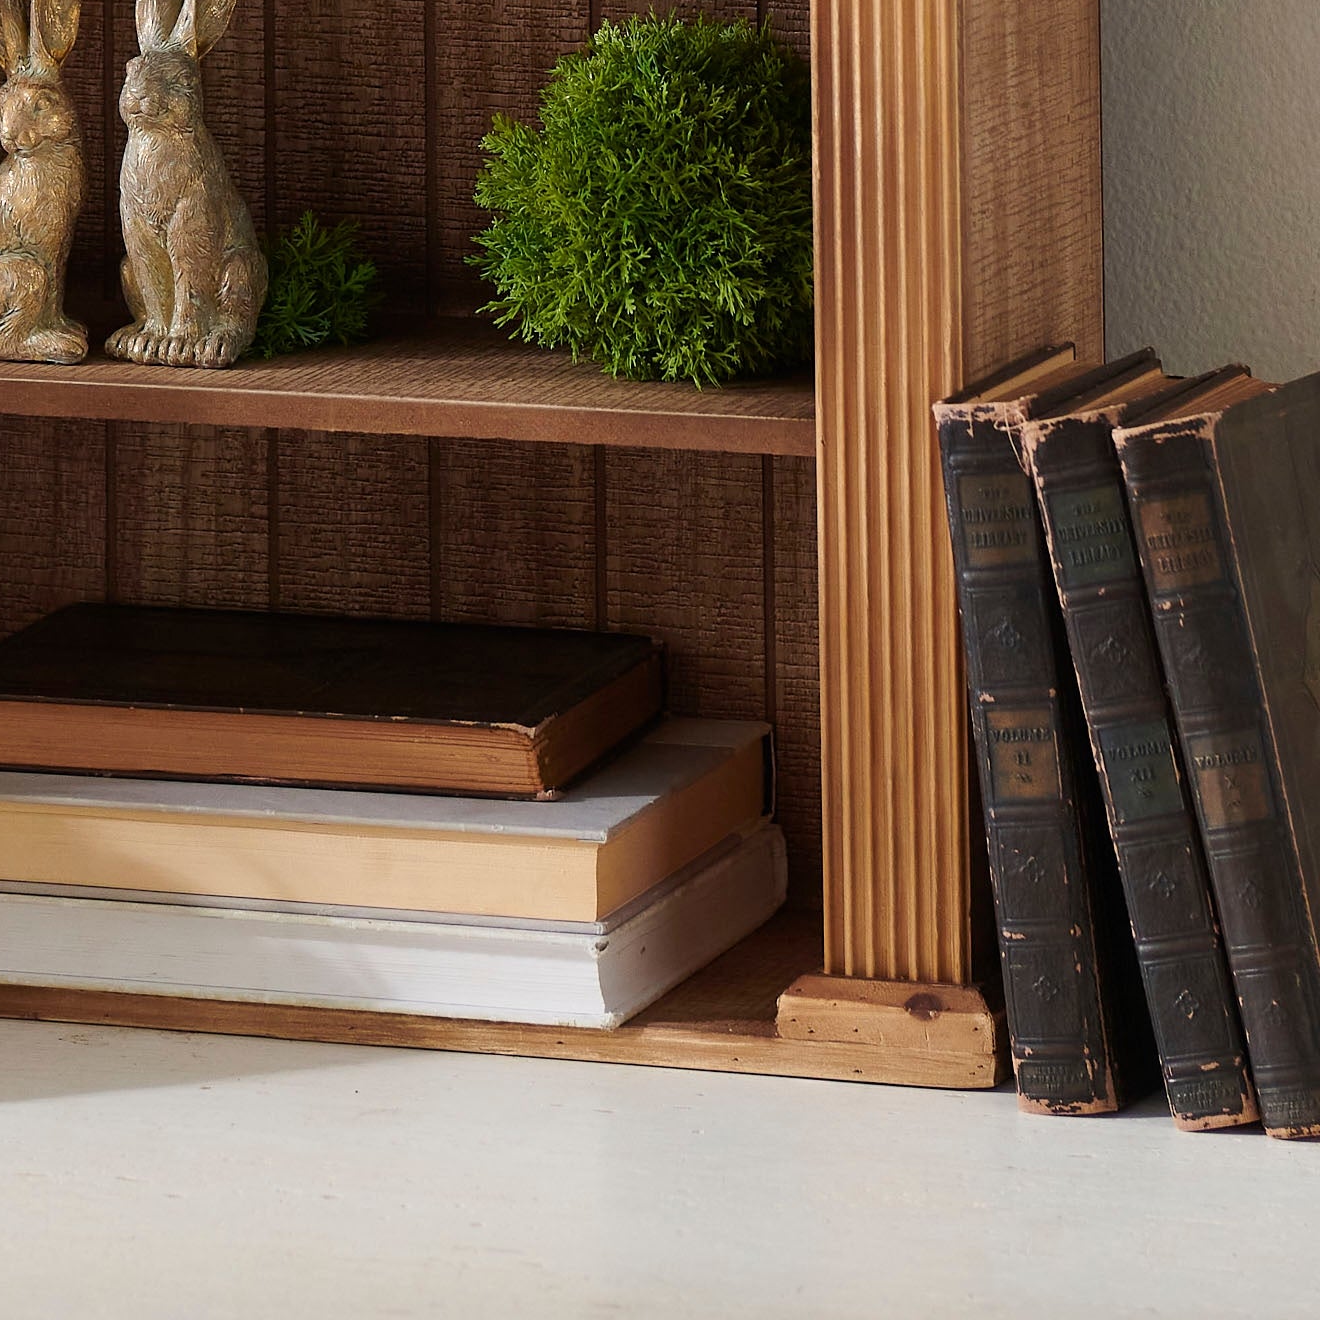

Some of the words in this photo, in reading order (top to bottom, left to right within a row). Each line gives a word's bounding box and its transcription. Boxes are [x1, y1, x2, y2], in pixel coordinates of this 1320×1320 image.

[1056, 518, 1127, 542] UNIVERSITY
[1068, 544, 1122, 566] LIBRARY
[988, 728, 1051, 743] VOLUME
[1108, 741, 1168, 761] VOLUME
